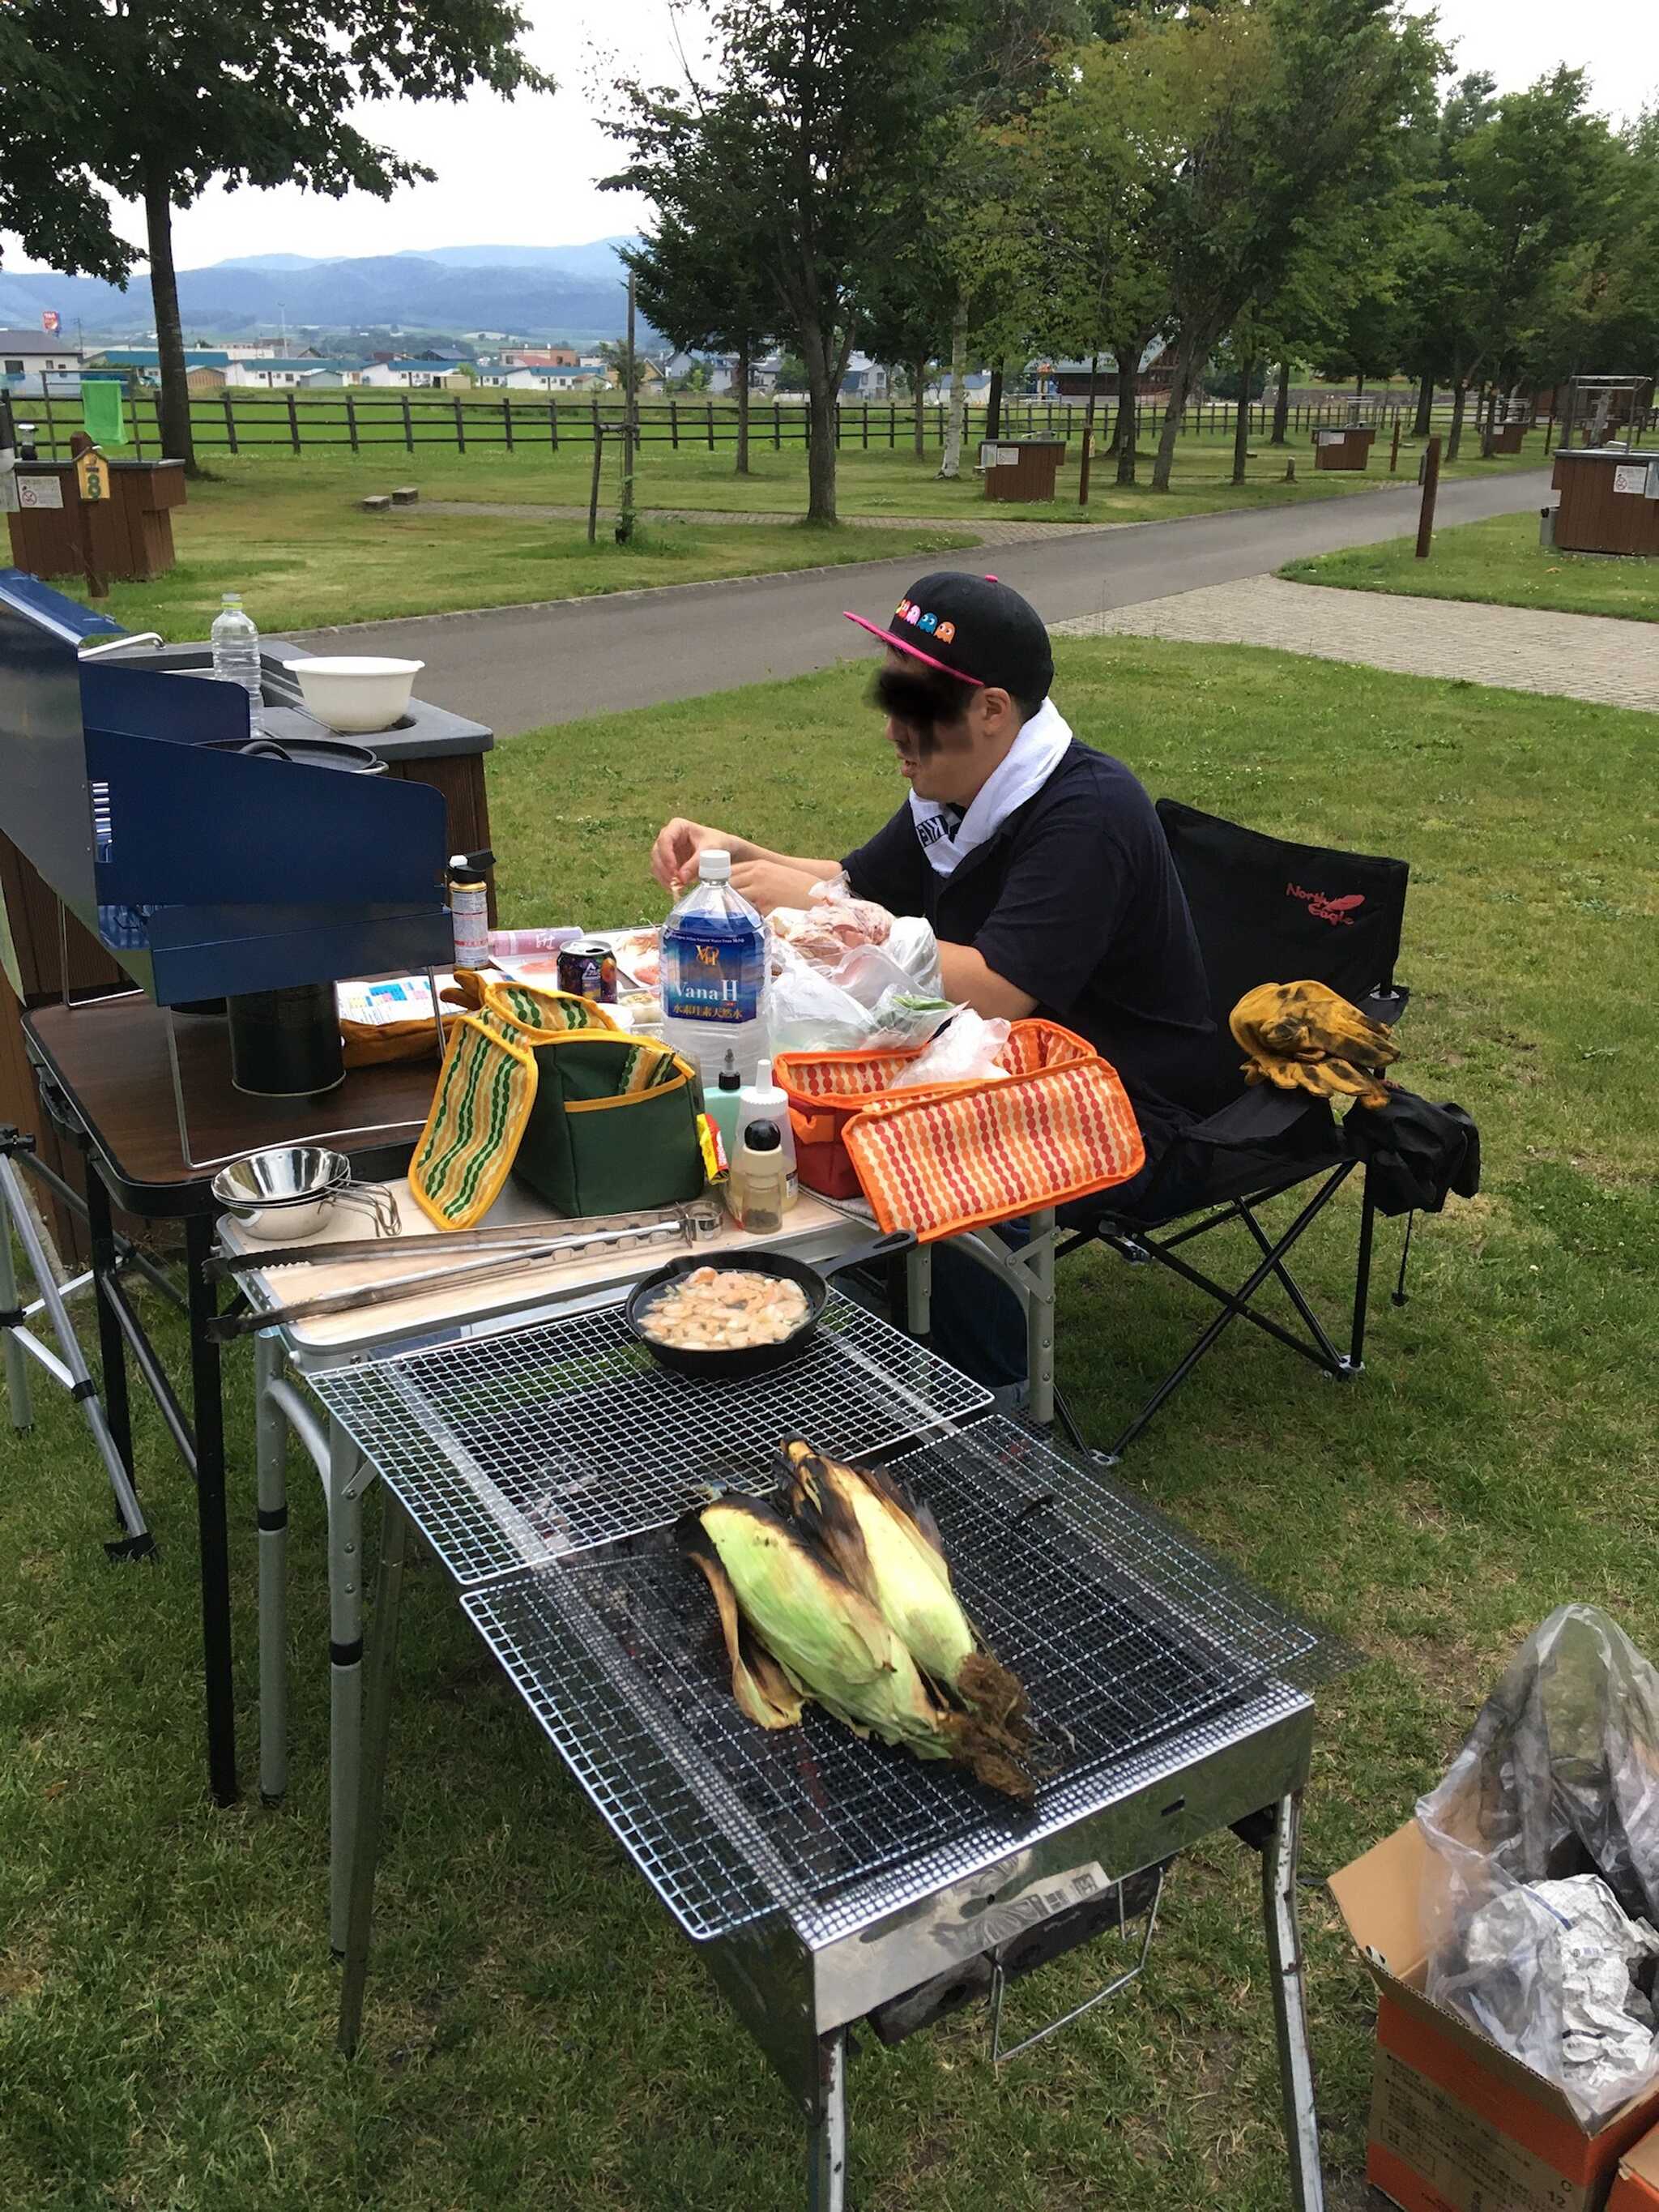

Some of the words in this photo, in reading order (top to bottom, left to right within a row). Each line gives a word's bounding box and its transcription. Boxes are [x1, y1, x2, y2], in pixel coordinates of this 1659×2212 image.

[87, 474, 101, 501] 8
[675, 981, 718, 1001] Vana
[721, 979, 738, 1001] H
